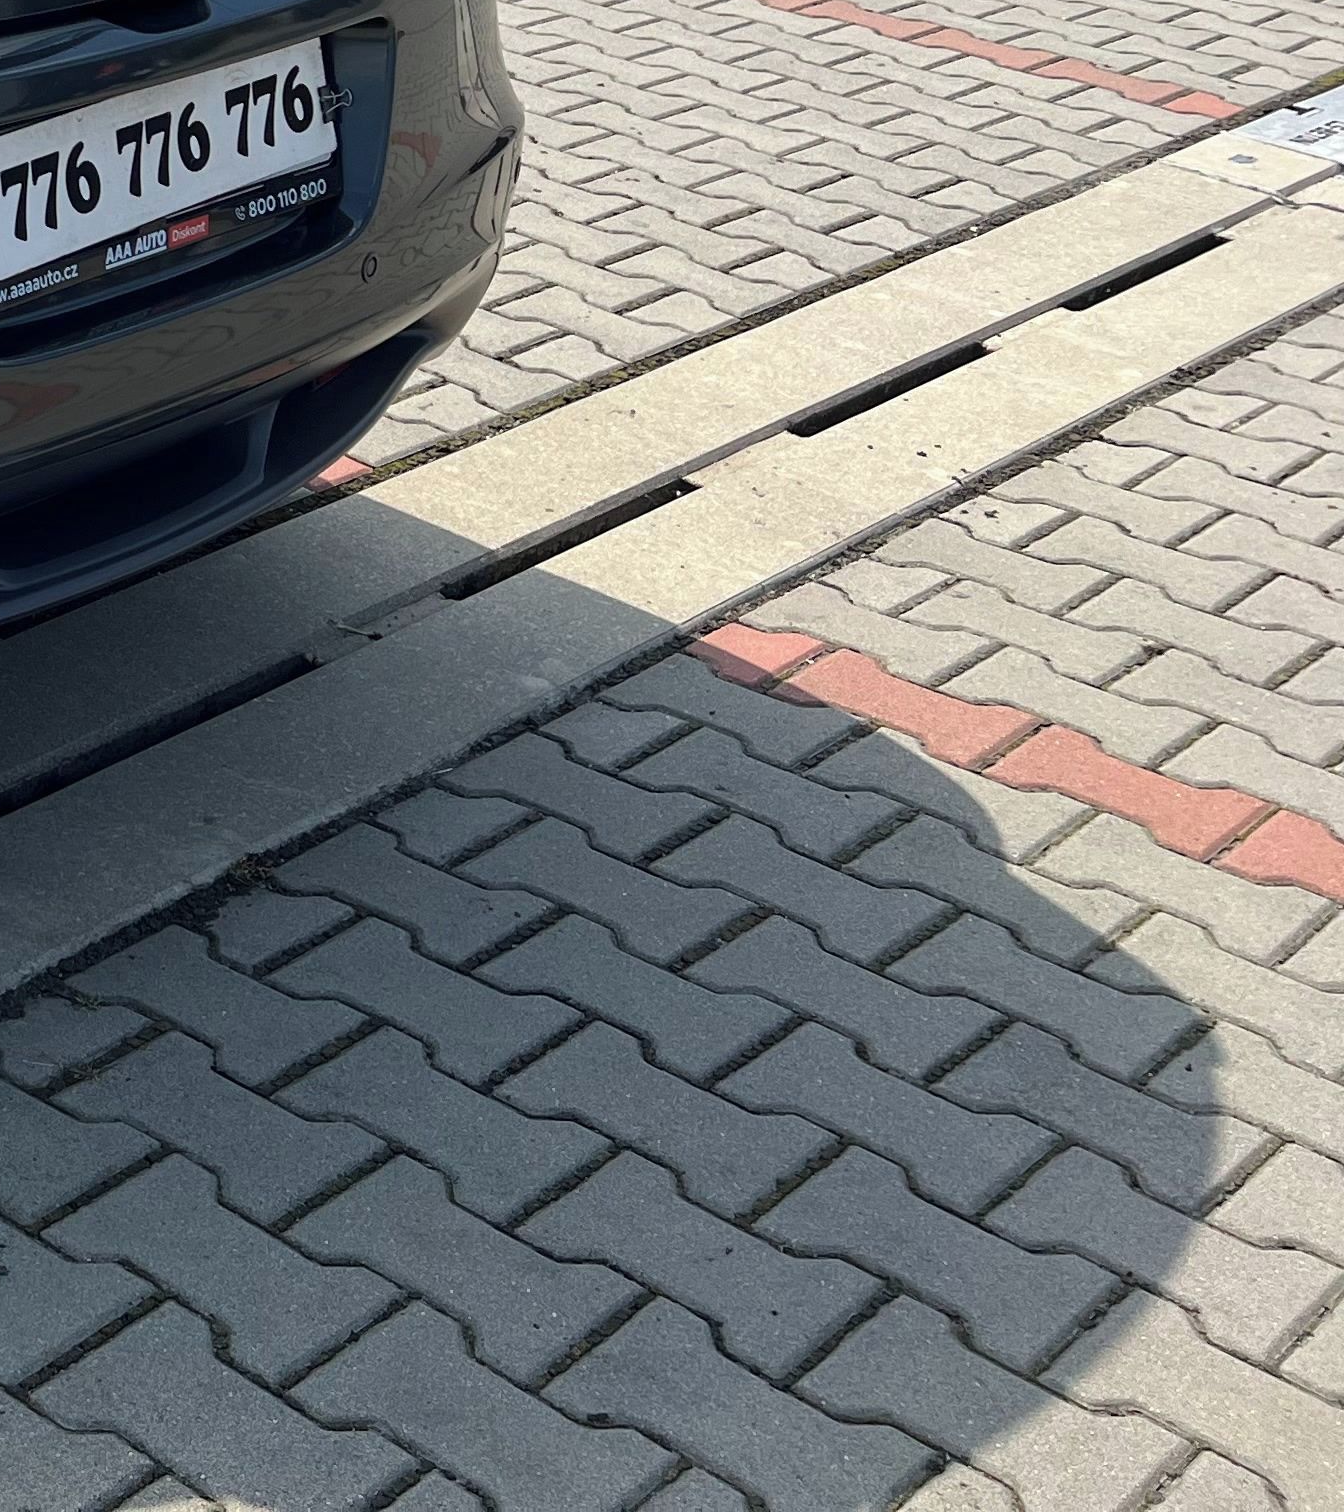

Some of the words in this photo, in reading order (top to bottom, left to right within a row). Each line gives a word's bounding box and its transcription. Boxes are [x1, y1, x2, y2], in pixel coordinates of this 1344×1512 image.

[0, 141, 101, 242] 776
[115, 101, 211, 198] 776
[224, 64, 314, 158] 776
[248, 197, 276, 218] 800
[277, 187, 298, 208] 110
[300, 178, 327, 200] 800
[105, 243, 133, 265] AAA
[134, 229, 167, 255] AUTO
[172, 221, 206, 242] Diskont
